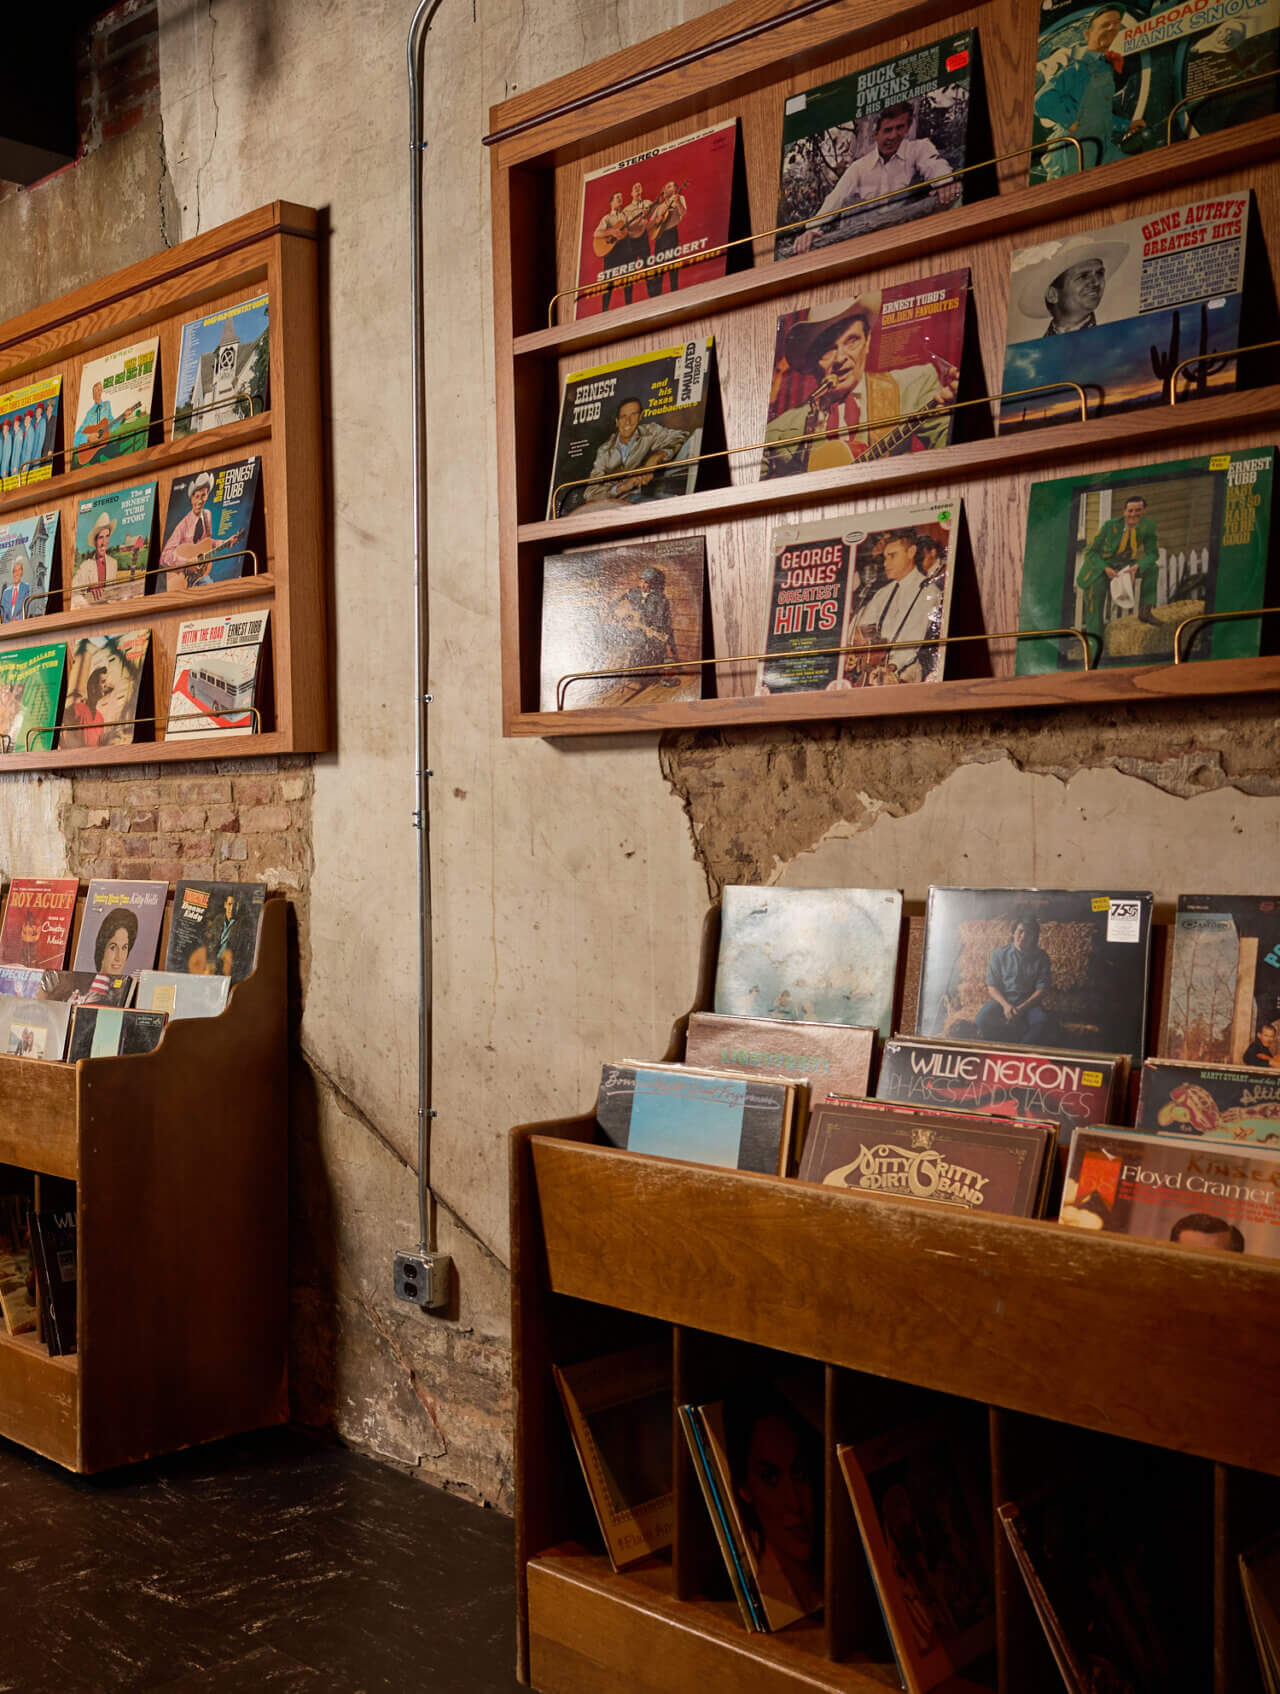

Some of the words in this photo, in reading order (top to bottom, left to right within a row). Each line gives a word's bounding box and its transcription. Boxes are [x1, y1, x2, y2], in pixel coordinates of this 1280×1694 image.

[1124, 0, 1209, 40] RAILROAD
[1123, 19, 1183, 53] HANK
[856, 72, 910, 107] OWENS
[858, 63, 897, 91] BUCK
[866, 101, 881, 114] HIS
[884, 80, 938, 108] BUCKAROOS
[618, 149, 660, 168] STEREO
[1142, 211, 1181, 240] GENE
[1184, 199, 1246, 225] AUTRY'S
[1144, 228, 1207, 257] GREATEST
[1212, 219, 1242, 240] HITS
[597, 259, 644, 282] STEREO
[646, 237, 708, 265] CONCERT
[881, 309, 913, 326] GOLDEN
[915, 297, 959, 318] FAVORITES
[882, 297, 915, 314] ERNEST
[916, 289, 946, 307] TUBB'S
[651, 377, 669, 390] and
[681, 342, 696, 401] SIMULATED
[693, 356, 702, 385] STEREO
[574, 378, 617, 405] ERNEST
[648, 396, 673, 408] Texas
[658, 387, 673, 397] his
[573, 401, 601, 424] TUBB
[224, 463, 255, 485] ERNEST
[1229, 456, 1272, 473] ERNEST
[224, 481, 244, 500] TUBB
[1227, 472, 1257, 487] TUBB
[93, 496, 119, 507] STEREO
[781, 544, 843, 570] GEORGE
[780, 561, 842, 590] JONES'
[777, 583, 840, 605] GREATEST
[228, 622, 248, 637] ERNEST
[774, 600, 838, 635] HITS
[10, 892, 34, 908] ROY
[32, 892, 74, 910] ACUFF
[911, 1051, 980, 1080] WILLIE
[982, 1059, 1080, 1091] NELSON
[1201, 1071, 1223, 1080] MARTY
[888, 1073, 960, 1102] PHASES
[1009, 1086, 1095, 1118] STAGES
[858, 1144, 913, 1174] NITTY
[937, 1176, 984, 1206] BAND
[1122, 1165, 1182, 1188] Floyd
[1186, 1176, 1274, 1204] Cramer
